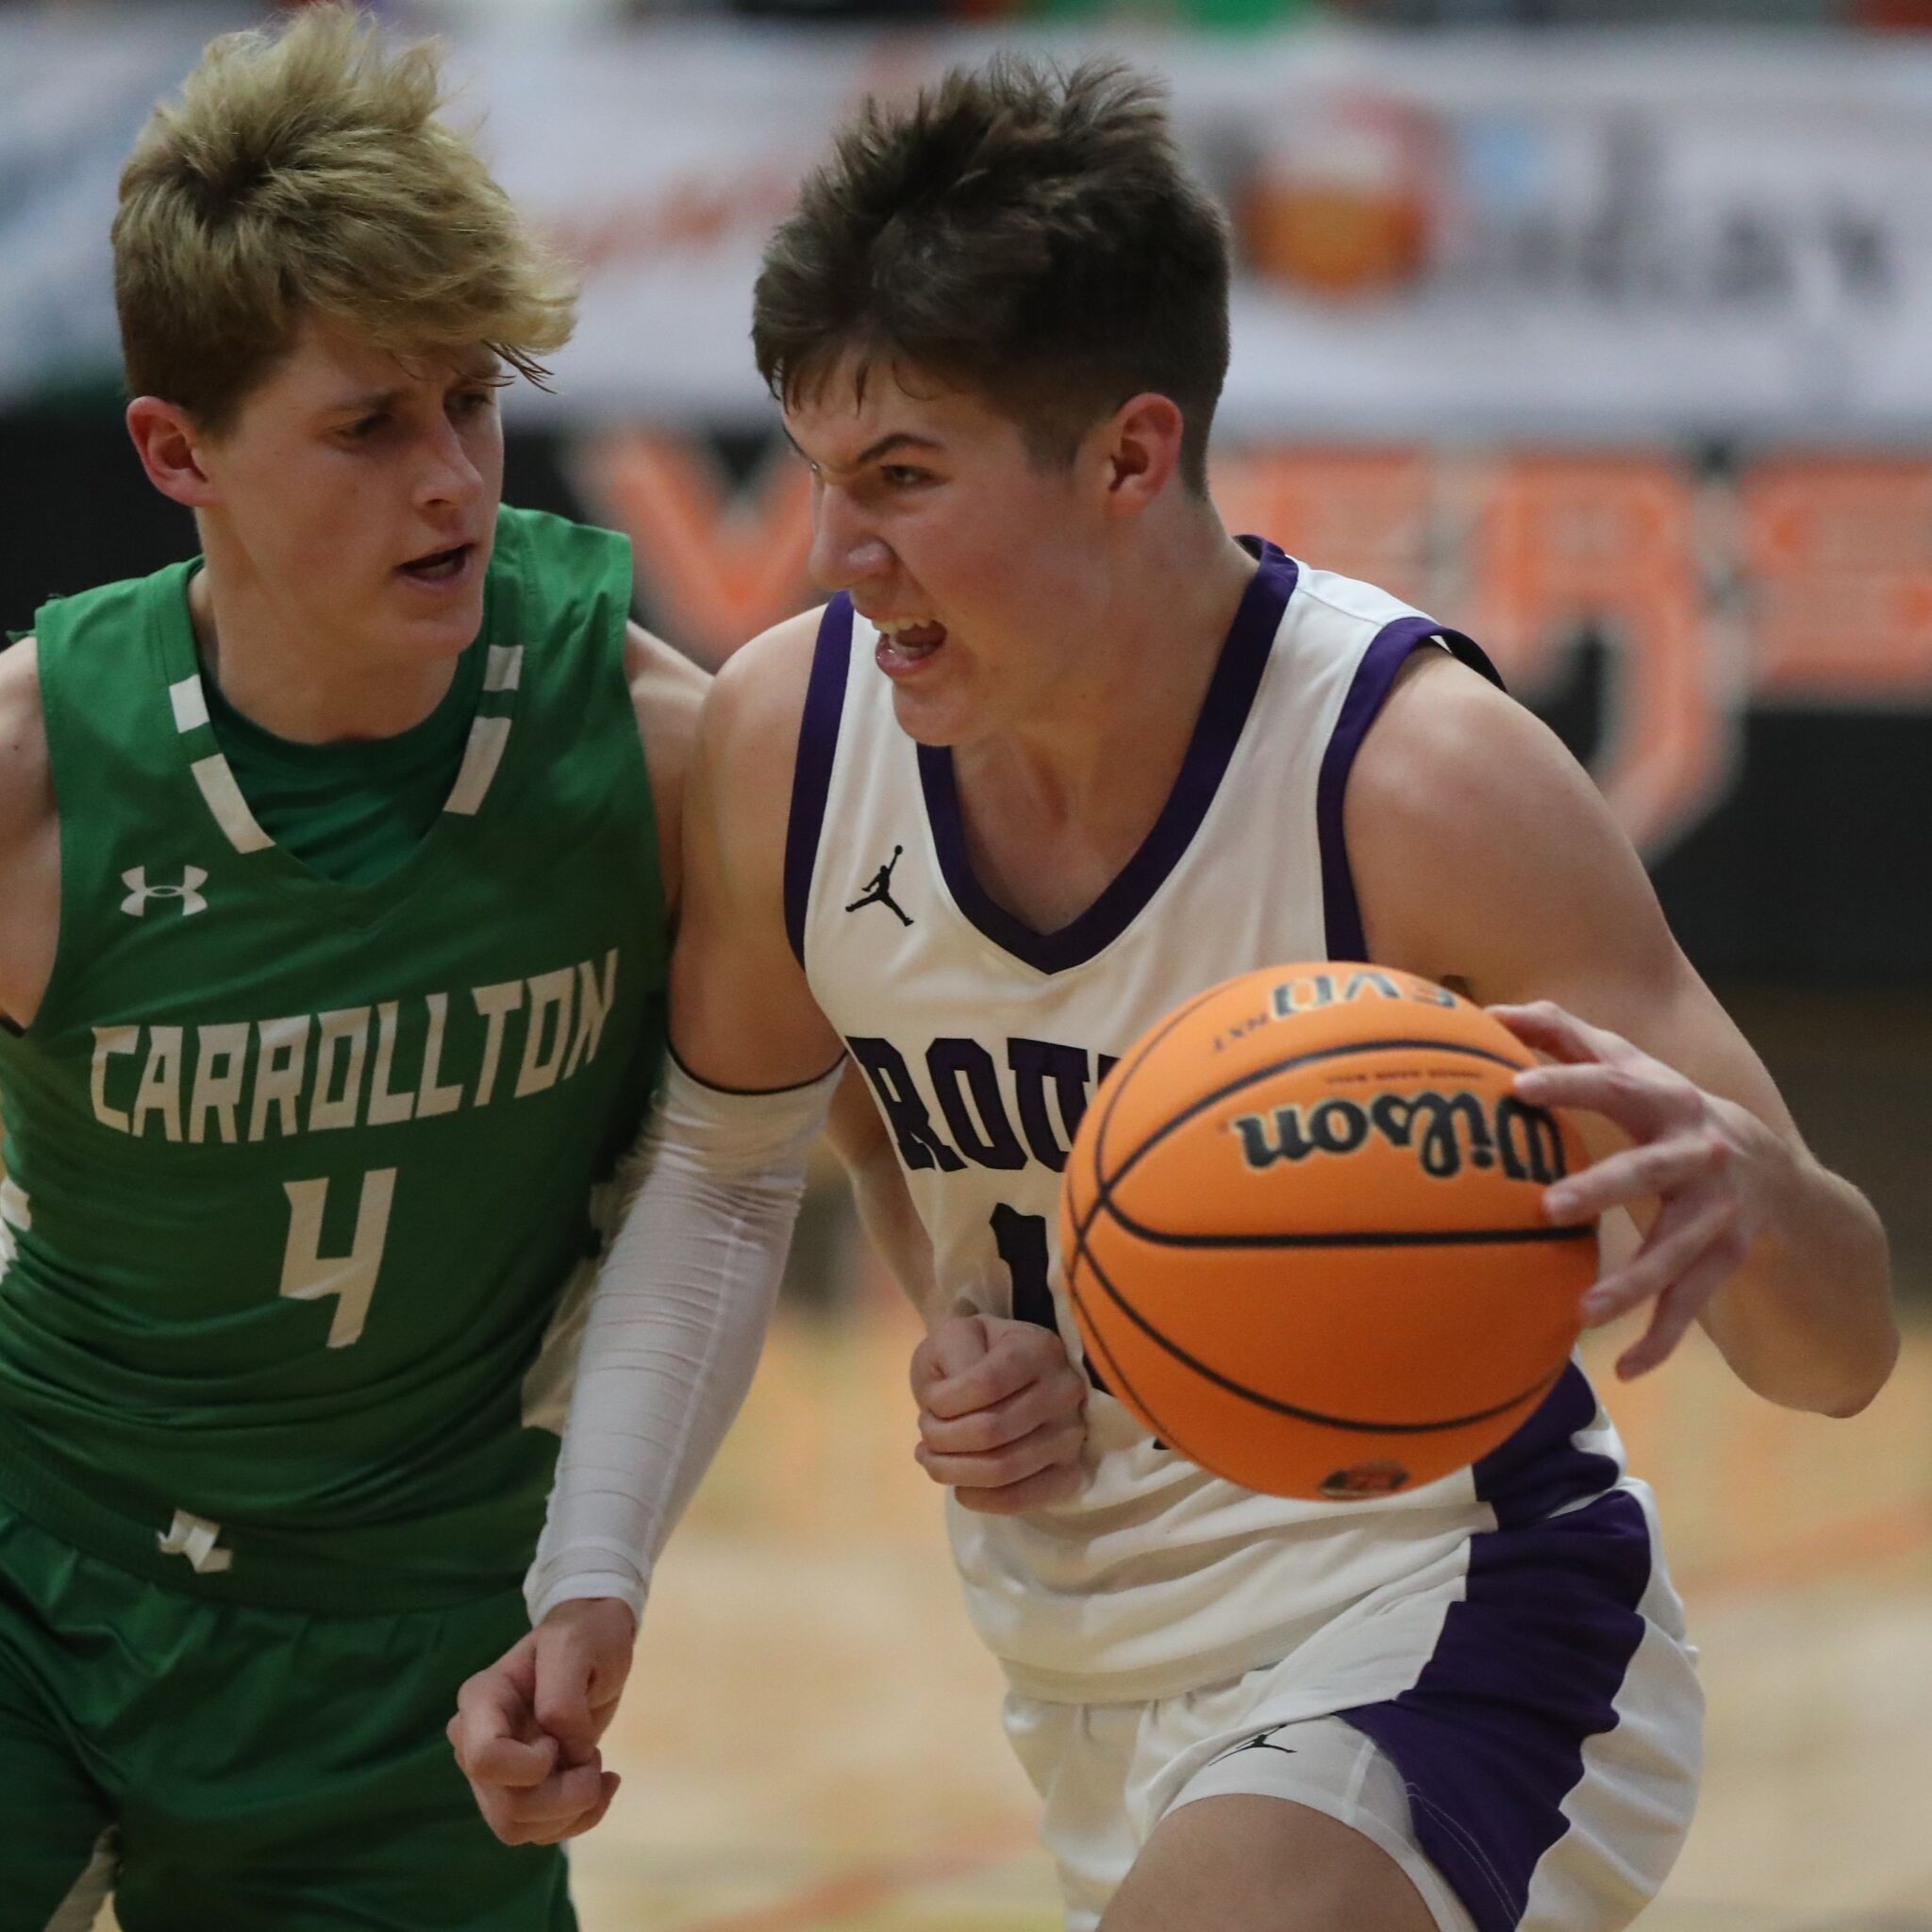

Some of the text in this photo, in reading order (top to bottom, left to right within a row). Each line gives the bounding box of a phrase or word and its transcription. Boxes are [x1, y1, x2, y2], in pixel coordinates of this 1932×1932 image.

[91, 948, 619, 1143] CARROLLTON
[845, 1036, 1121, 1173] ROU
[1234, 1089, 1566, 1184] Wilson
[279, 1167, 397, 1349] 4
